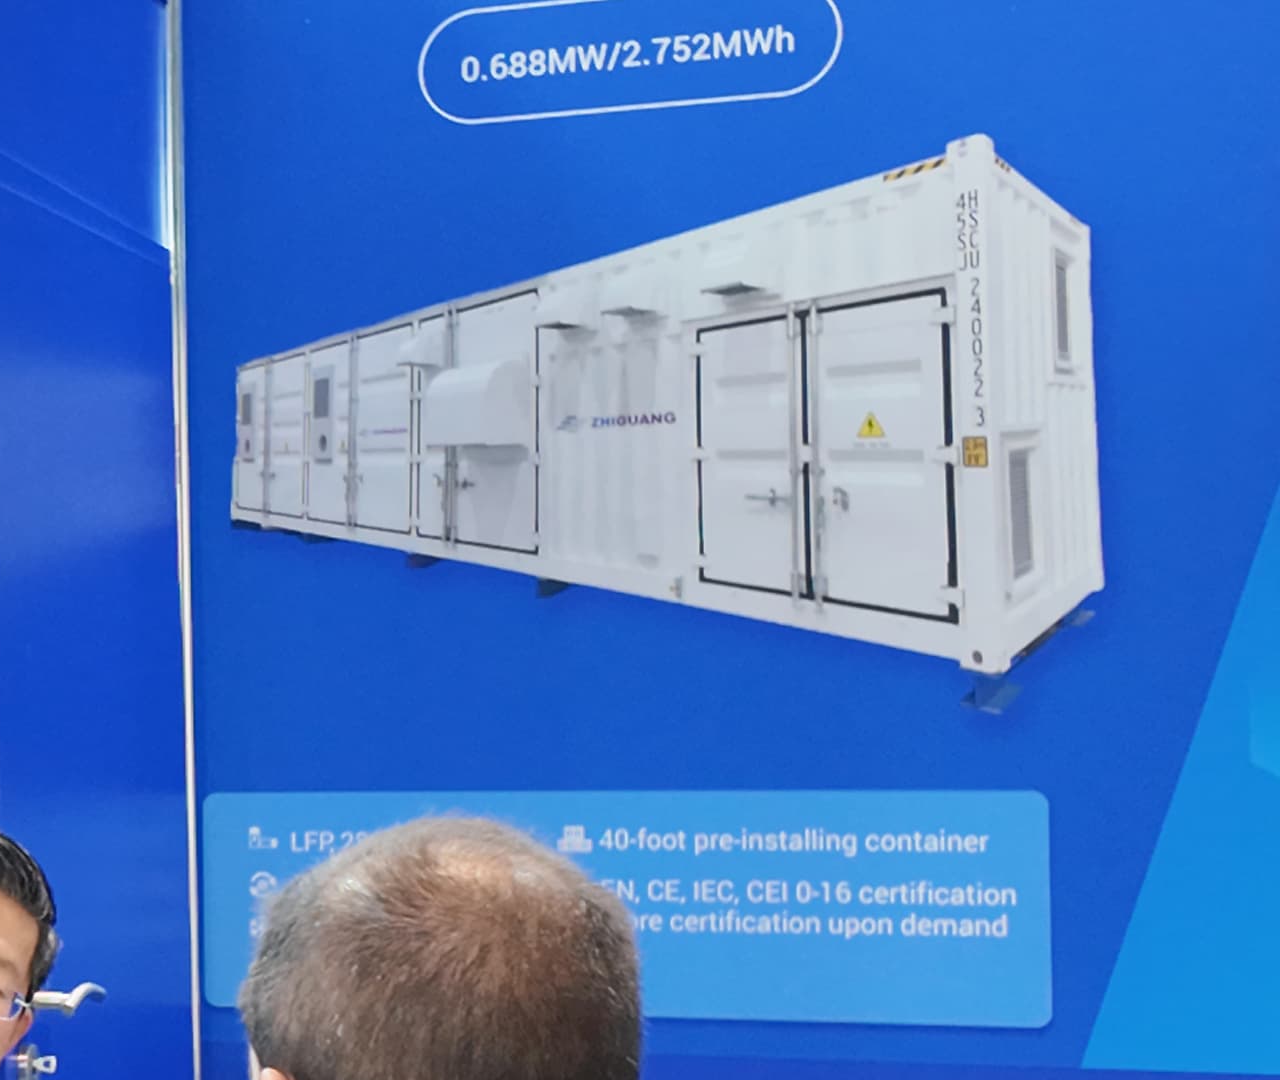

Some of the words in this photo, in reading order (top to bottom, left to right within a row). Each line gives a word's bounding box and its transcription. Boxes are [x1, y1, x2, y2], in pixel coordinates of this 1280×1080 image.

[460, 24, 796, 84] 0.688MW/2.752MWh
[591, 411, 677, 428] ZHIGUANG
[599, 826, 686, 852] 40-foot
[694, 826, 859, 857] pre-installing
[865, 829, 989, 853] container
[647, 879, 686, 905] CE,
[693, 879, 740, 905] IEC,
[746, 880, 788, 904] CEI
[796, 881, 852, 904] 0-16
[859, 880, 1018, 906] certification
[670, 909, 822, 934] certification
[828, 914, 893, 940] upon
[900, 912, 1008, 938] demand
